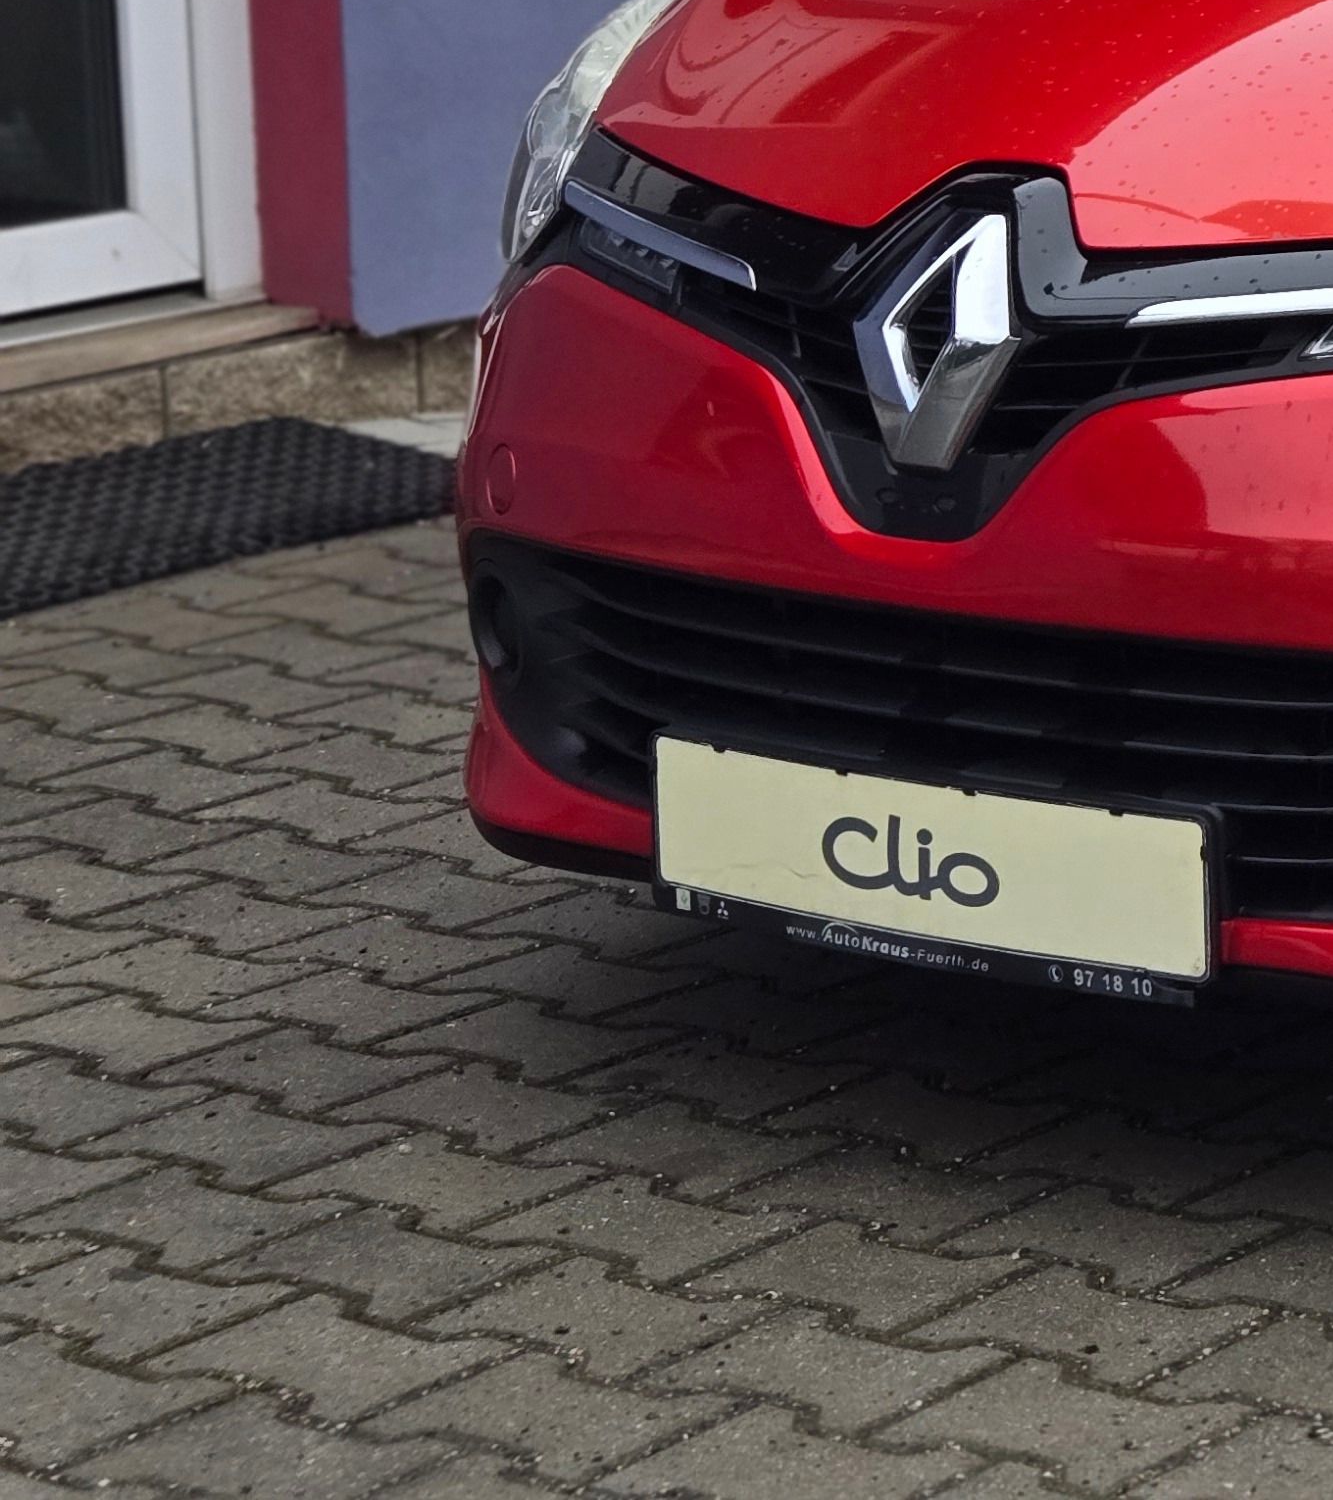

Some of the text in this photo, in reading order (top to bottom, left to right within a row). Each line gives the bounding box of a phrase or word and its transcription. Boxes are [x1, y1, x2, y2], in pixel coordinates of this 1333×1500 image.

[821, 814, 1001, 908] Clio
[1073, 968, 1153, 997] 97 18 10
